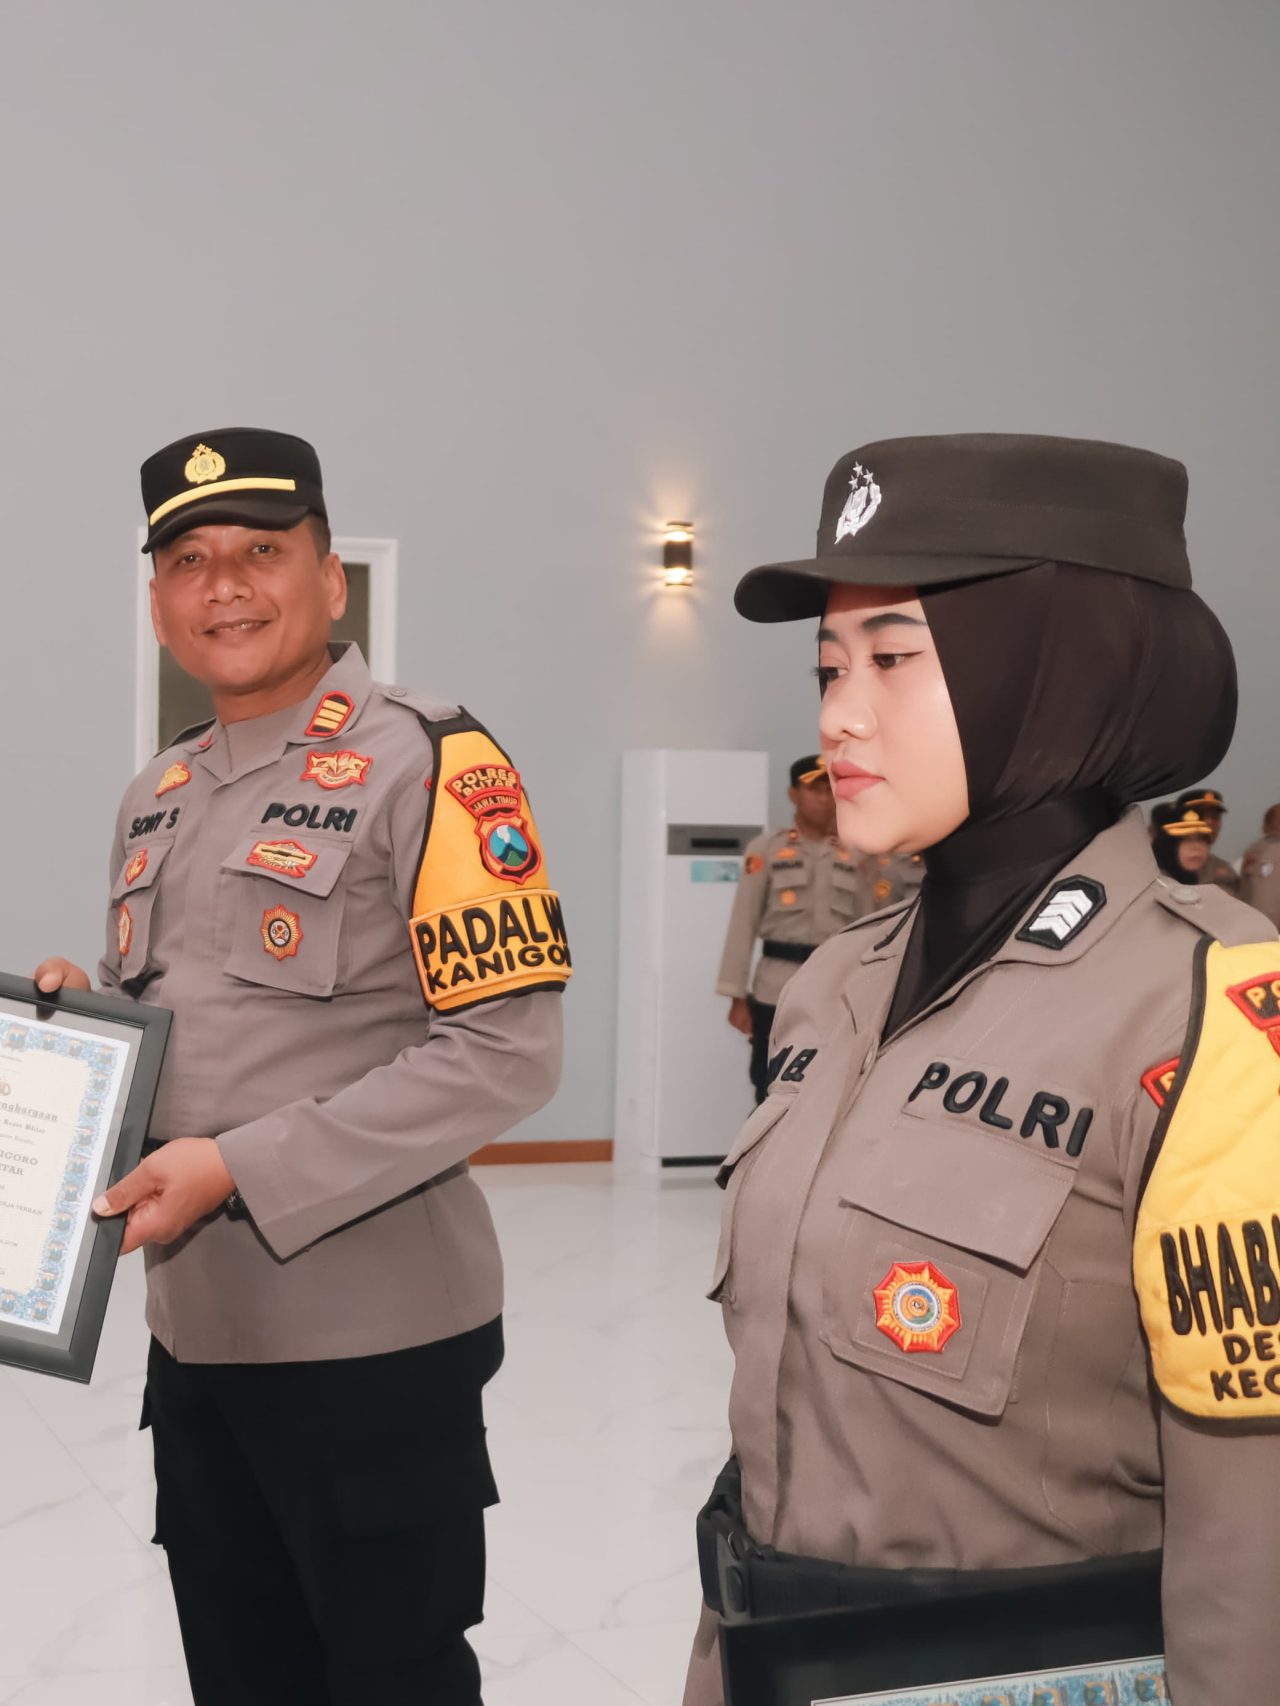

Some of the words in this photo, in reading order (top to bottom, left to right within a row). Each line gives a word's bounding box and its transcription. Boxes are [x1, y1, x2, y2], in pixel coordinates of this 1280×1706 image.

[451, 767, 517, 793] POLRES
[462, 778, 515, 797] BLITAR
[261, 803, 357, 832] POLRI
[473, 797, 496, 812] JAWA
[166, 807, 180, 829] S
[908, 1062, 1094, 1157] POLRI
[1222, 1330, 1280, 1366] DE
